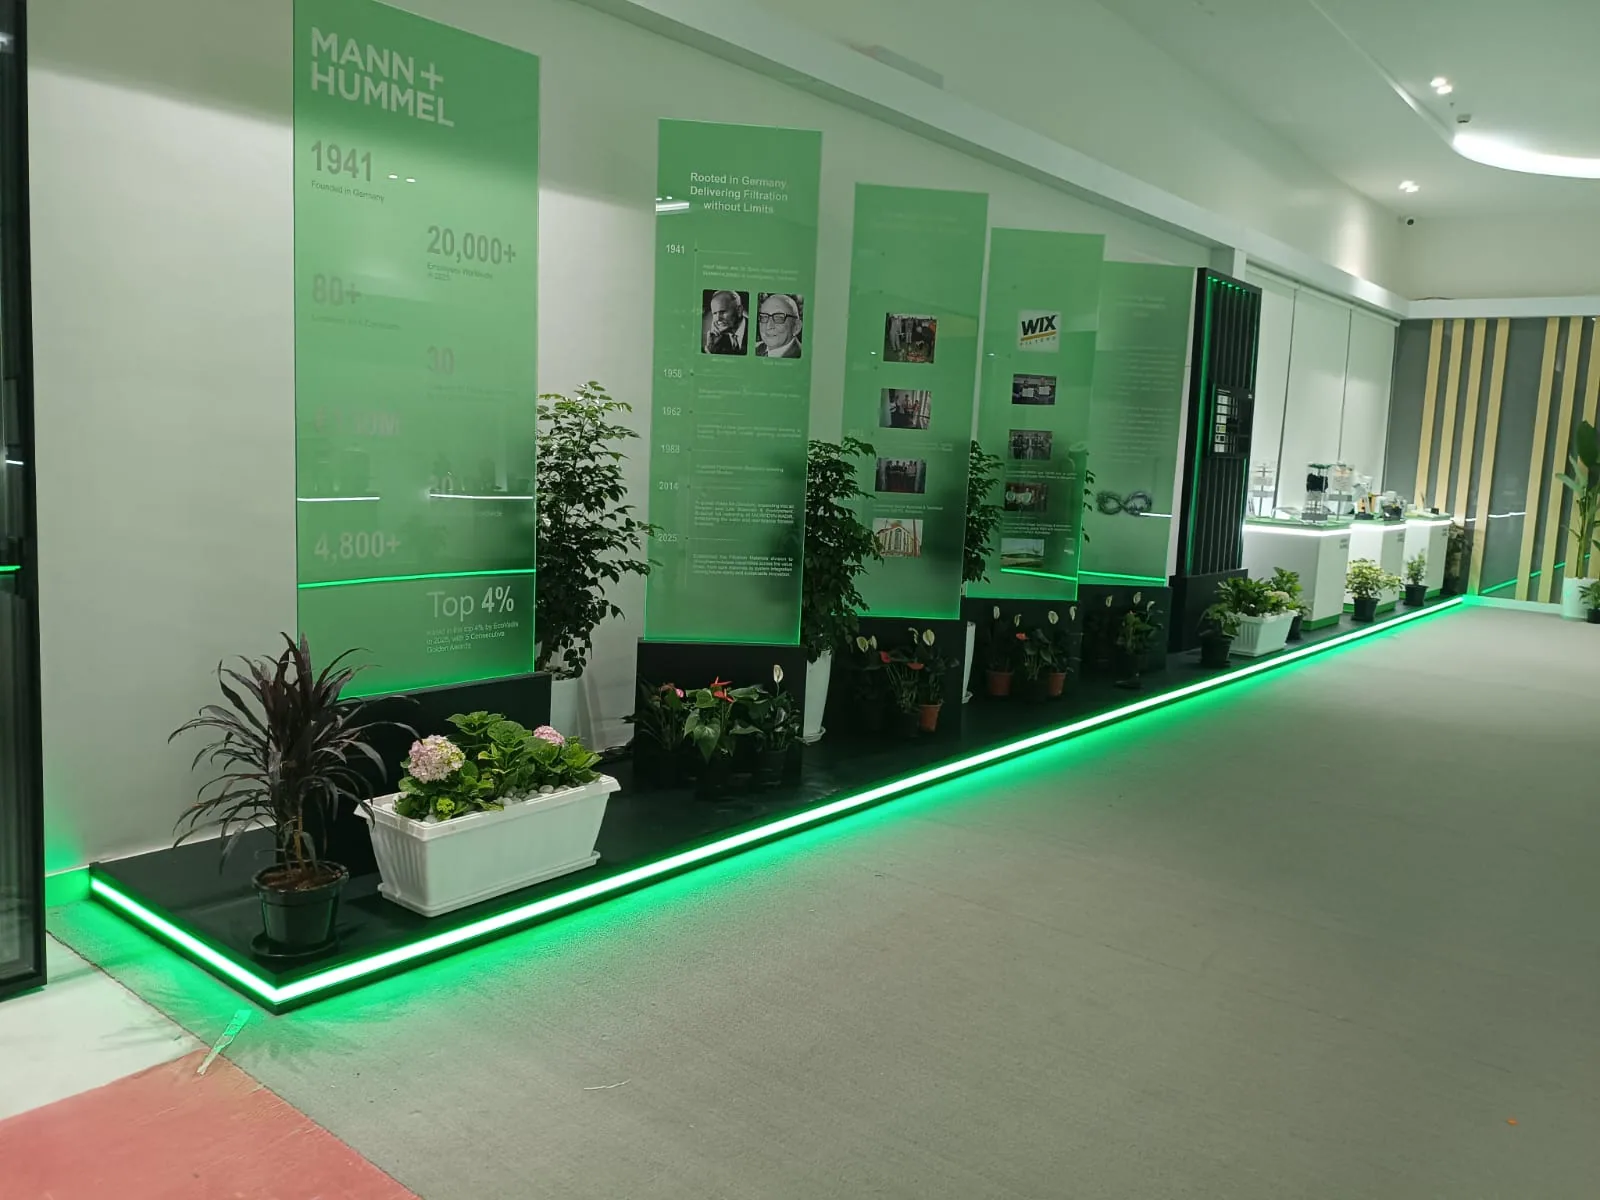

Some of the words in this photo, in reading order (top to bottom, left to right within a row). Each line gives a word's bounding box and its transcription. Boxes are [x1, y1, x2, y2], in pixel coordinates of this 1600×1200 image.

[311, 61, 455, 128] HUMMEL
[311, 140, 372, 182] 1941
[311, 180, 343, 194] Founded
[344, 187, 351, 197] in
[353, 188, 385, 205] Germany
[690, 172, 727, 184] Rooted
[729, 175, 739, 185] in
[741, 176, 787, 190] Germany
[690, 186, 741, 199] Delivering
[743, 189, 788, 201] Filtration
[703, 201, 741, 212] without
[743, 203, 774, 214] Limits
[426, 225, 516, 265] 20,000+
[665, 243, 685, 255] 1941
[311, 273, 362, 306] 80+
[1021, 314, 1057, 336] WIX
[662, 406, 682, 416] 1962
[314, 530, 401, 564] 4,800+
[425, 589, 475, 622] Top
[481, 584, 515, 613] 4%
